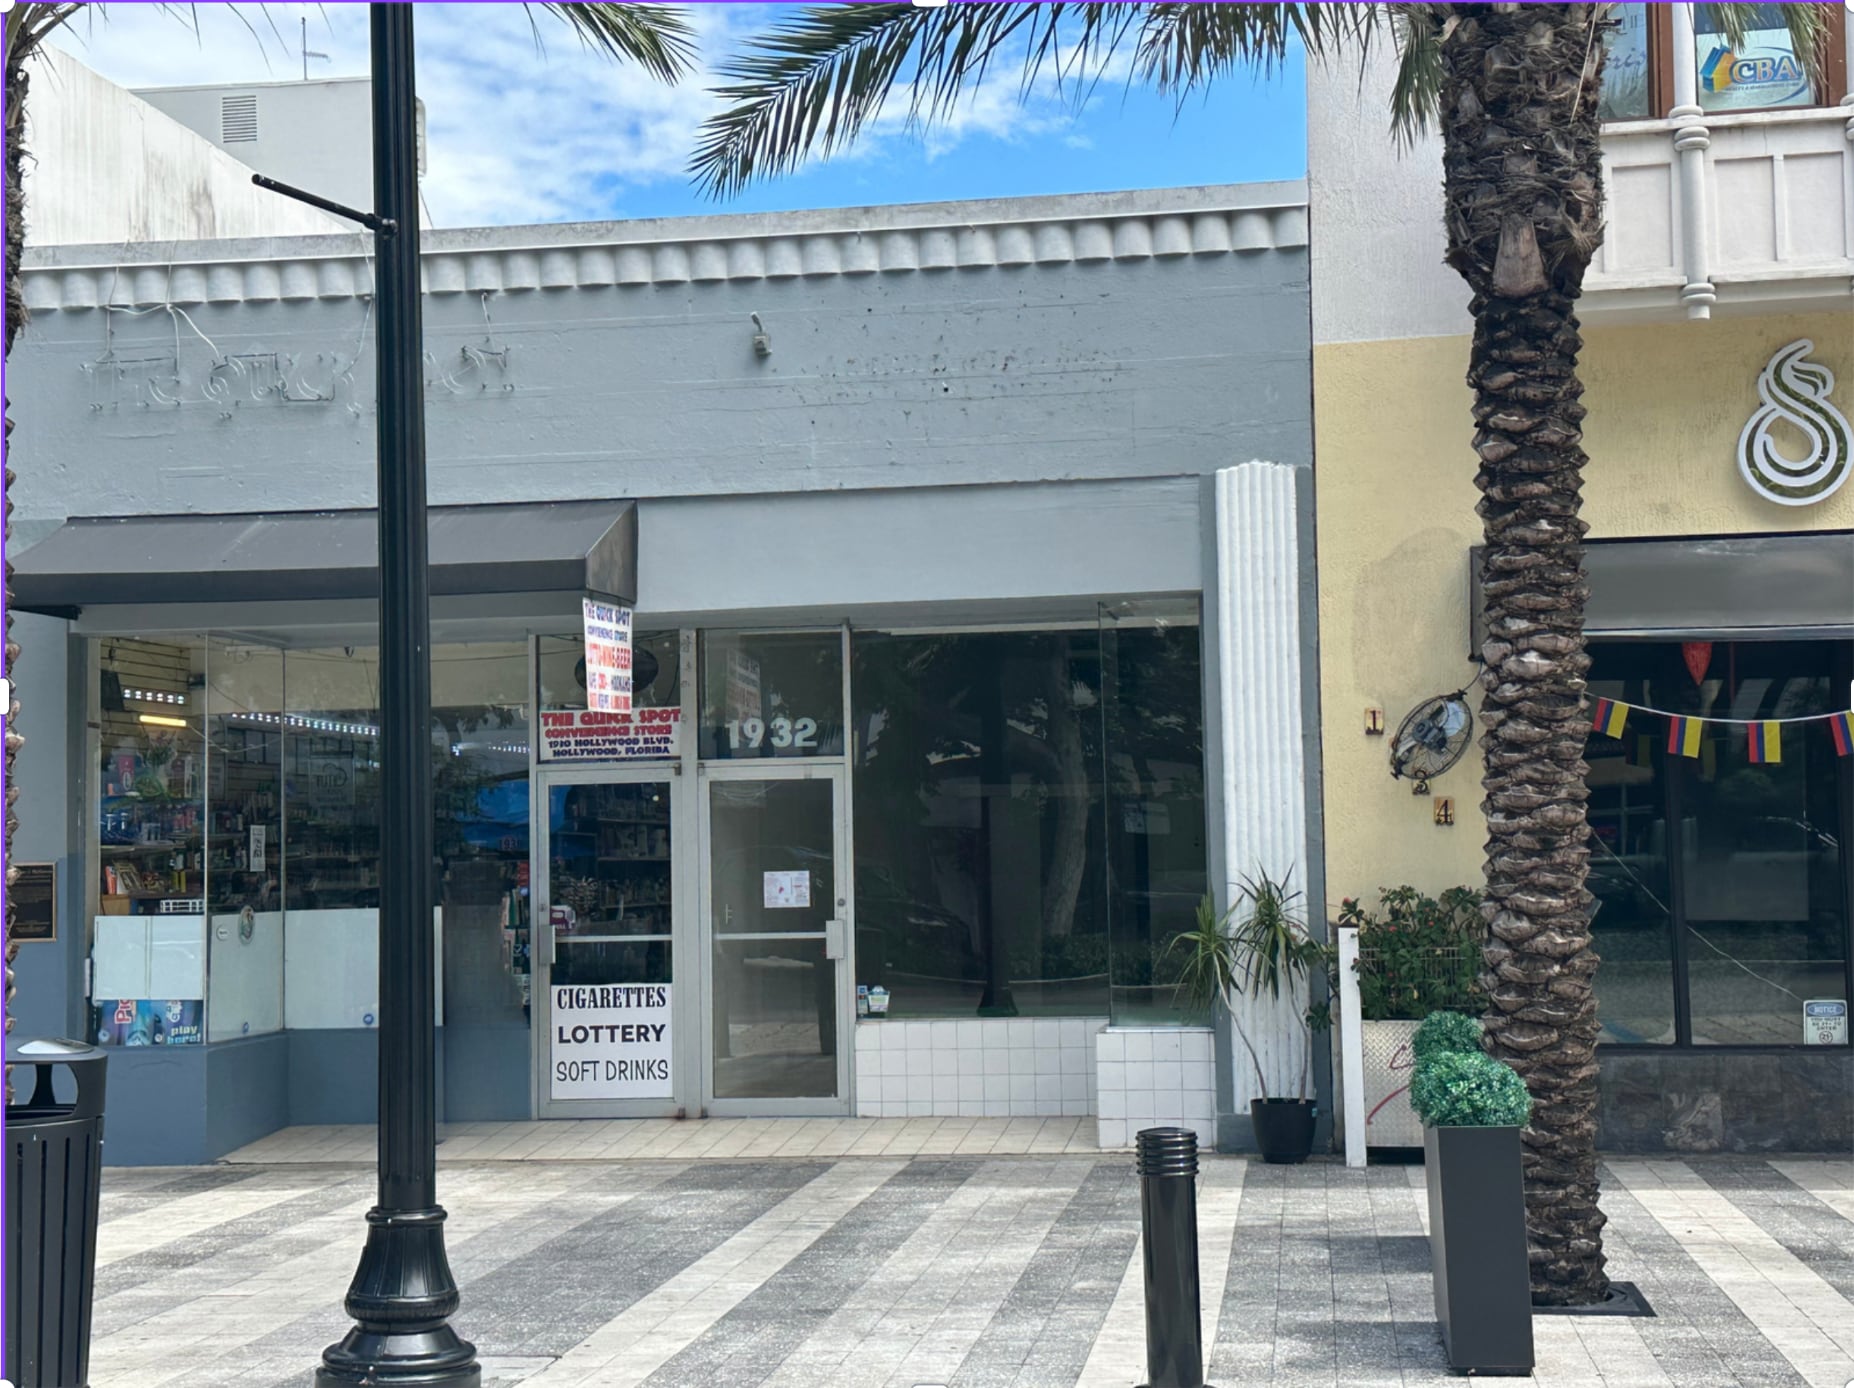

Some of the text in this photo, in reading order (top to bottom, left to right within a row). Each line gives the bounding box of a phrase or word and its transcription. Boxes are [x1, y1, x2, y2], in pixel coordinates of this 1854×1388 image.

[1730, 56, 1800, 83] CBA
[541, 708, 681, 727] THE QUICK SPOT
[545, 724, 673, 739] CONVENIENCE STORE
[724, 717, 818, 749] 1932
[553, 746, 670, 757] HOLLYWOOD, FLORIDA
[574, 738, 640, 748] HOLLYWOOD
[643, 736, 675, 746] BLVD.
[557, 987, 666, 1009] CIGARETTES
[558, 1024, 666, 1044] LOTTERY
[556, 1059, 668, 1081] SOFT DRINKS
